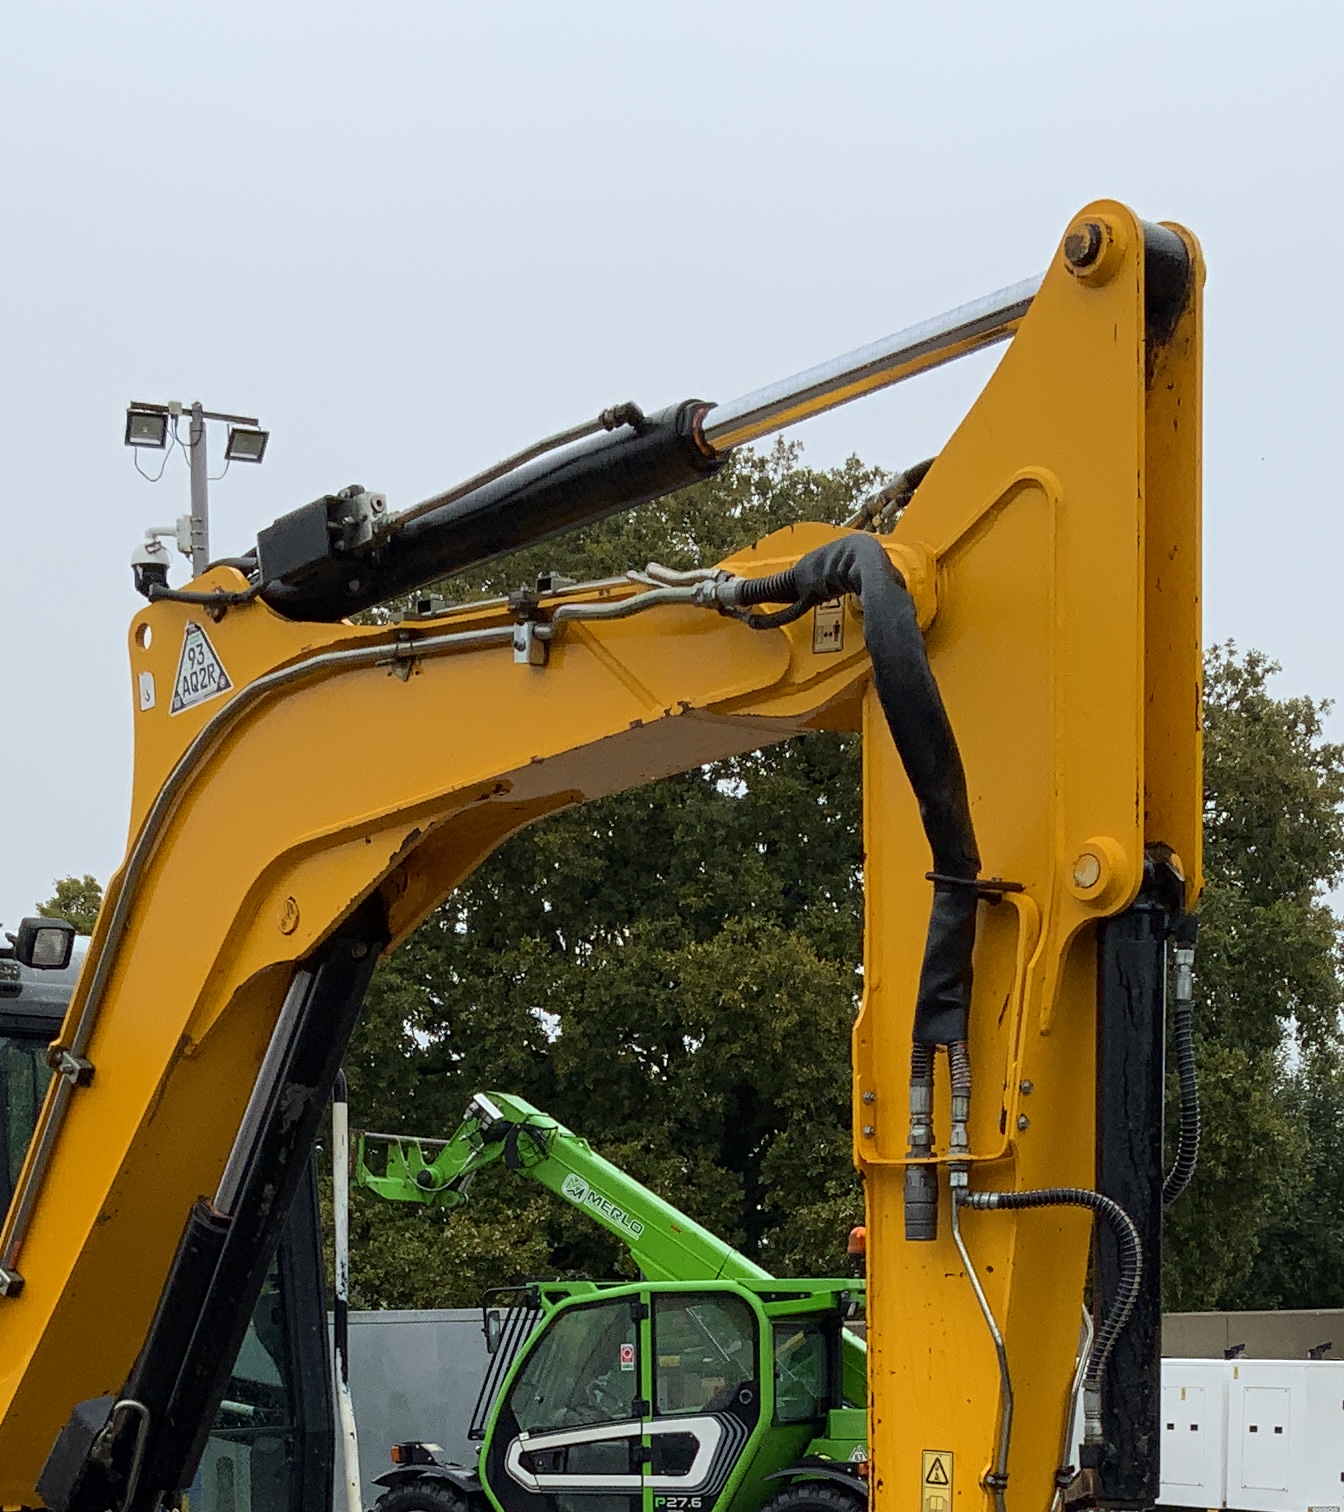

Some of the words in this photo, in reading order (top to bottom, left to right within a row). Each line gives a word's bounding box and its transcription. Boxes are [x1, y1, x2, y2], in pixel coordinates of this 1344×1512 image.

[188, 643, 205, 671] 93
[182, 663, 217, 697] AQ2R
[587, 1191, 643, 1234] MERLO
[655, 1497, 702, 1508] P27.6
